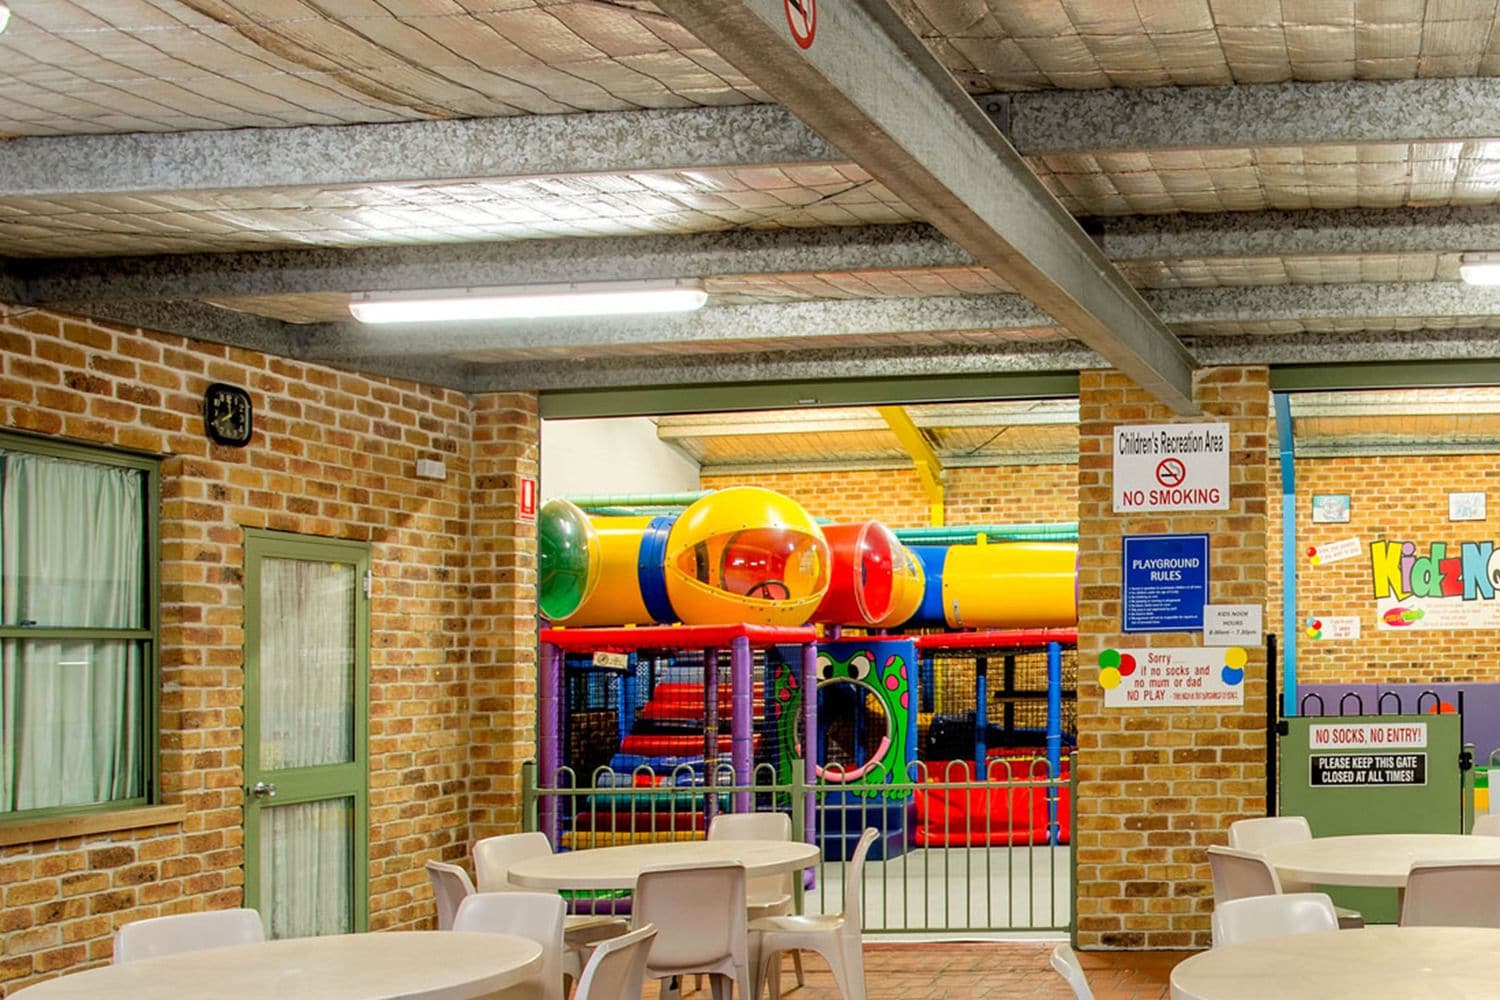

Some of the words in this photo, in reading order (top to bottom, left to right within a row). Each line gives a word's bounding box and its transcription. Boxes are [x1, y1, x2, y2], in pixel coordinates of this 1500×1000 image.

[1119, 431, 1159, 455] Children's
[1161, 430, 1203, 454] Recreation
[1204, 430, 1223, 453] Area
[1123, 490, 1145, 506] NO
[1149, 488, 1220, 505] SMOKING
[1132, 558, 1199, 569] PLAYGROUND
[1150, 570, 1181, 581] RULES
[1141, 666, 1146, 676] if
[1151, 667, 1161, 676] no
[1166, 666, 1189, 676] socks
[1194, 665, 1210, 676] and
[1134, 679, 1144, 688] no
[1149, 679, 1169, 687] mum
[1173, 679, 1182, 687] or
[1186, 677, 1202, 687] dad
[1127, 690, 1139, 700] NO
[1144, 690, 1165, 700] PLAY
[1316, 729, 1329, 743] NO
[1332, 728, 1367, 744] SOCKS,
[1370, 728, 1384, 743] NO
[1387, 727, 1421, 742] ENTRY!
[1319, 757, 1351, 769] PLEASE
[1352, 756, 1373, 768] KEEP
[1375, 756, 1394, 768] THIS
[1396, 756, 1417, 768] GATE
[1322, 770, 1354, 783] CLOSED
[1356, 770, 1366, 782] AT
[1368, 770, 1384, 782] ALL
[1385, 769, 1414, 782] TIMES!
